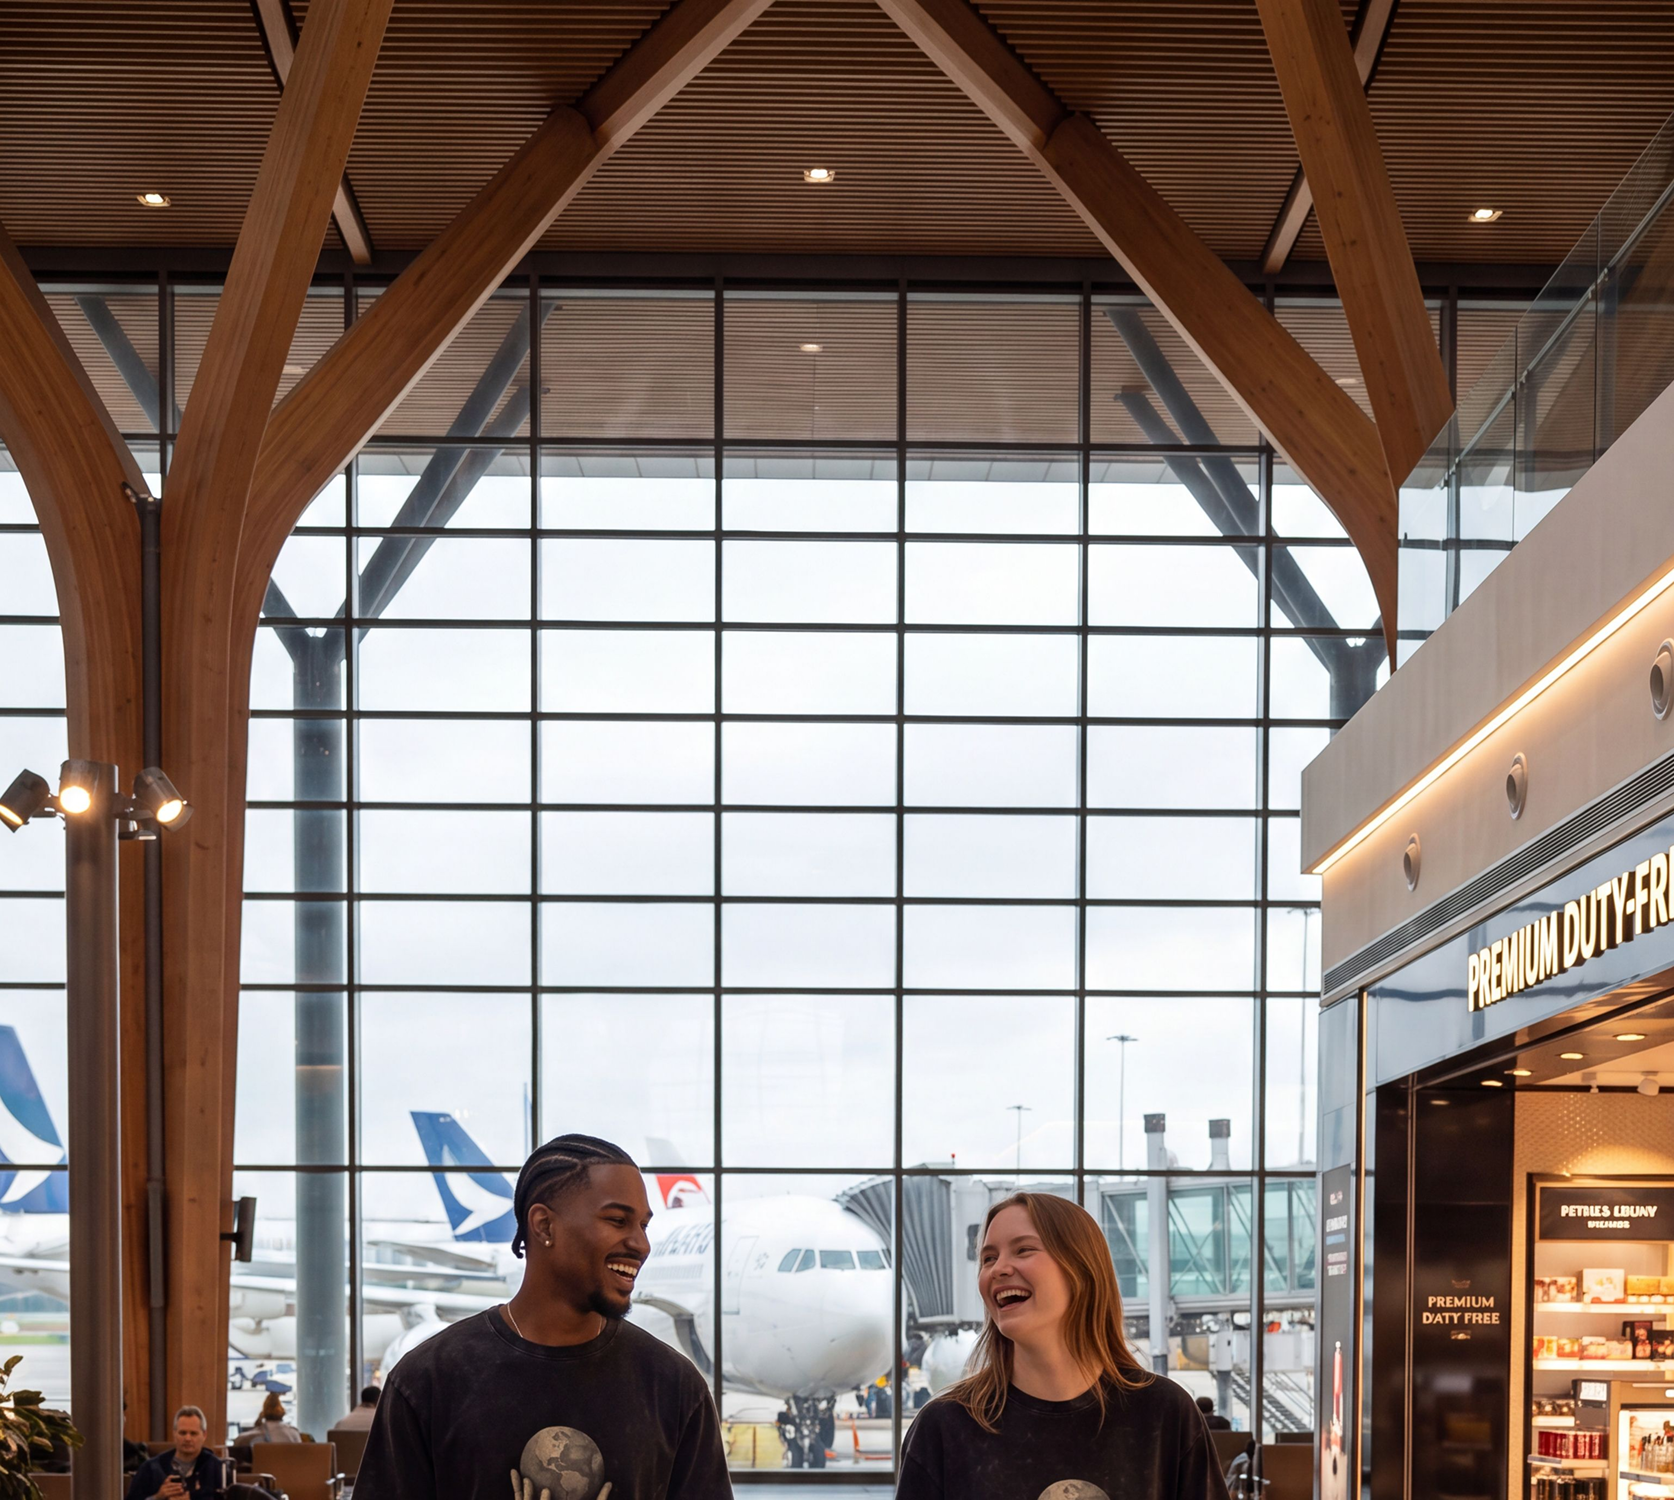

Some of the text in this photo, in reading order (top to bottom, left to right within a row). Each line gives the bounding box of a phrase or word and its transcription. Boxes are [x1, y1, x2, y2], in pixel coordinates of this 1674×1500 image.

[1468, 910, 1558, 1012] PREMIUM
[1428, 1296, 1494, 1308] PREMIUM
[1464, 1312, 1500, 1325] FREE
